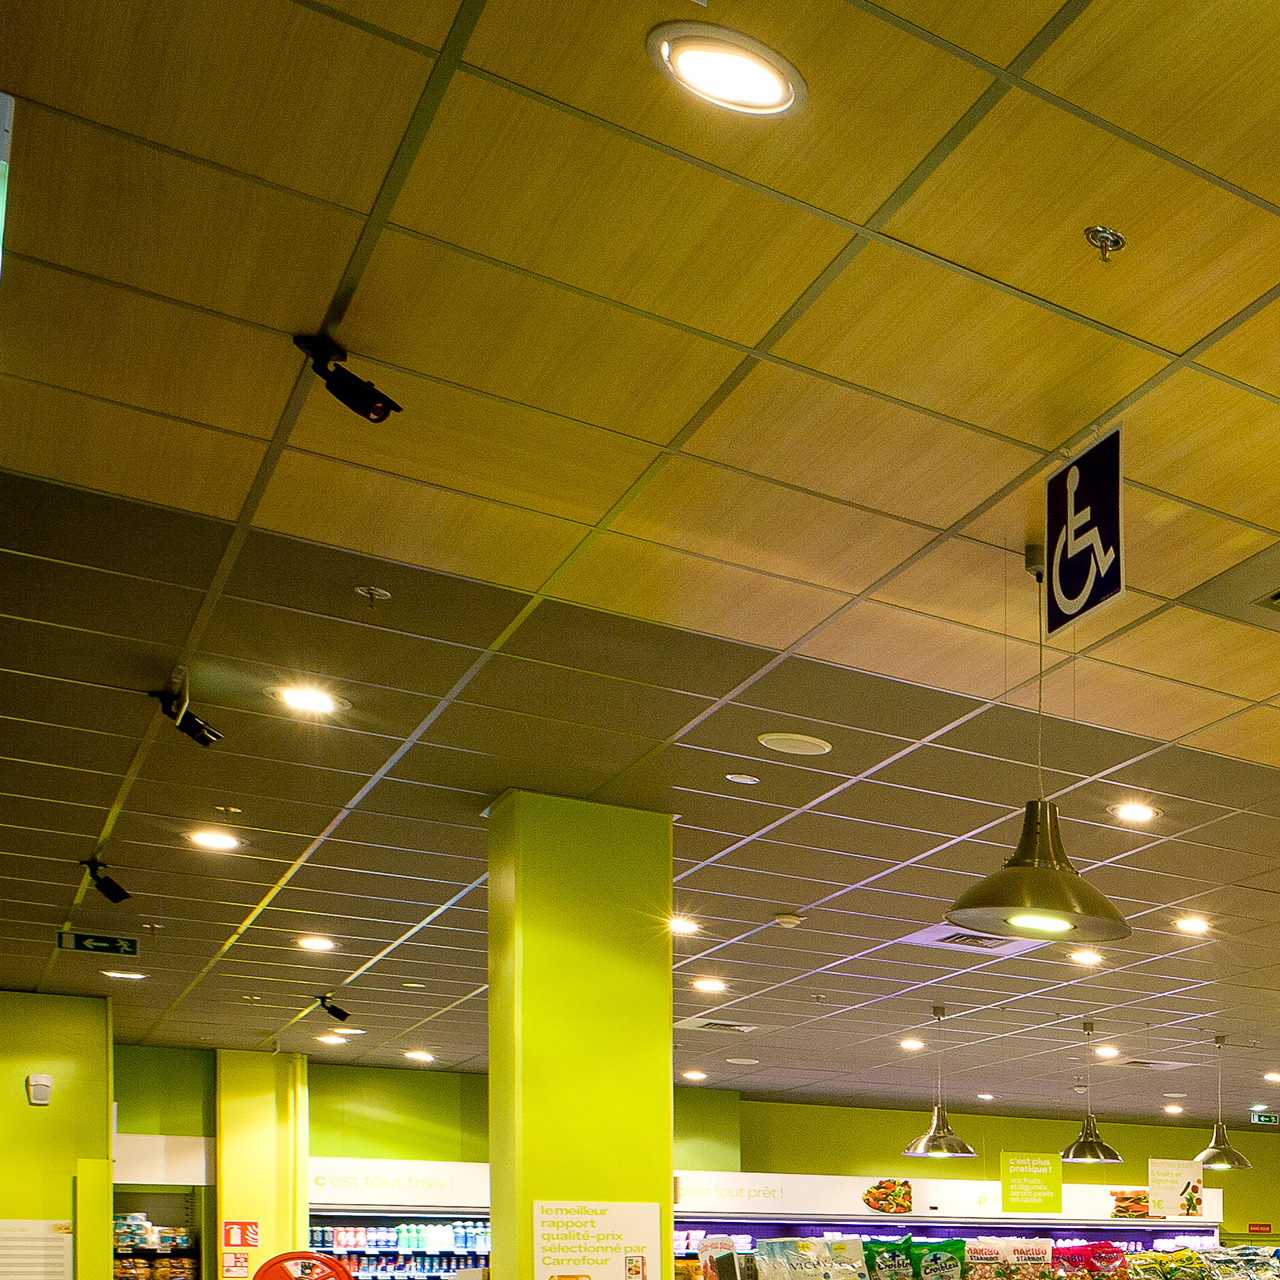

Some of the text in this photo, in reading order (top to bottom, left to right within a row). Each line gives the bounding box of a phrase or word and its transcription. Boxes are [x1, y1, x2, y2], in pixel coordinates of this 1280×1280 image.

[1009, 1165, 1047, 1174] pratique
[747, 1186, 778, 1199] prêt
[541, 1205, 609, 1216] le meilleur
[541, 1219, 596, 1230] rapport
[542, 1231, 623, 1242] qualité-prix
[541, 1243, 647, 1255] sélectionné par
[542, 1255, 610, 1265] Carrefour
